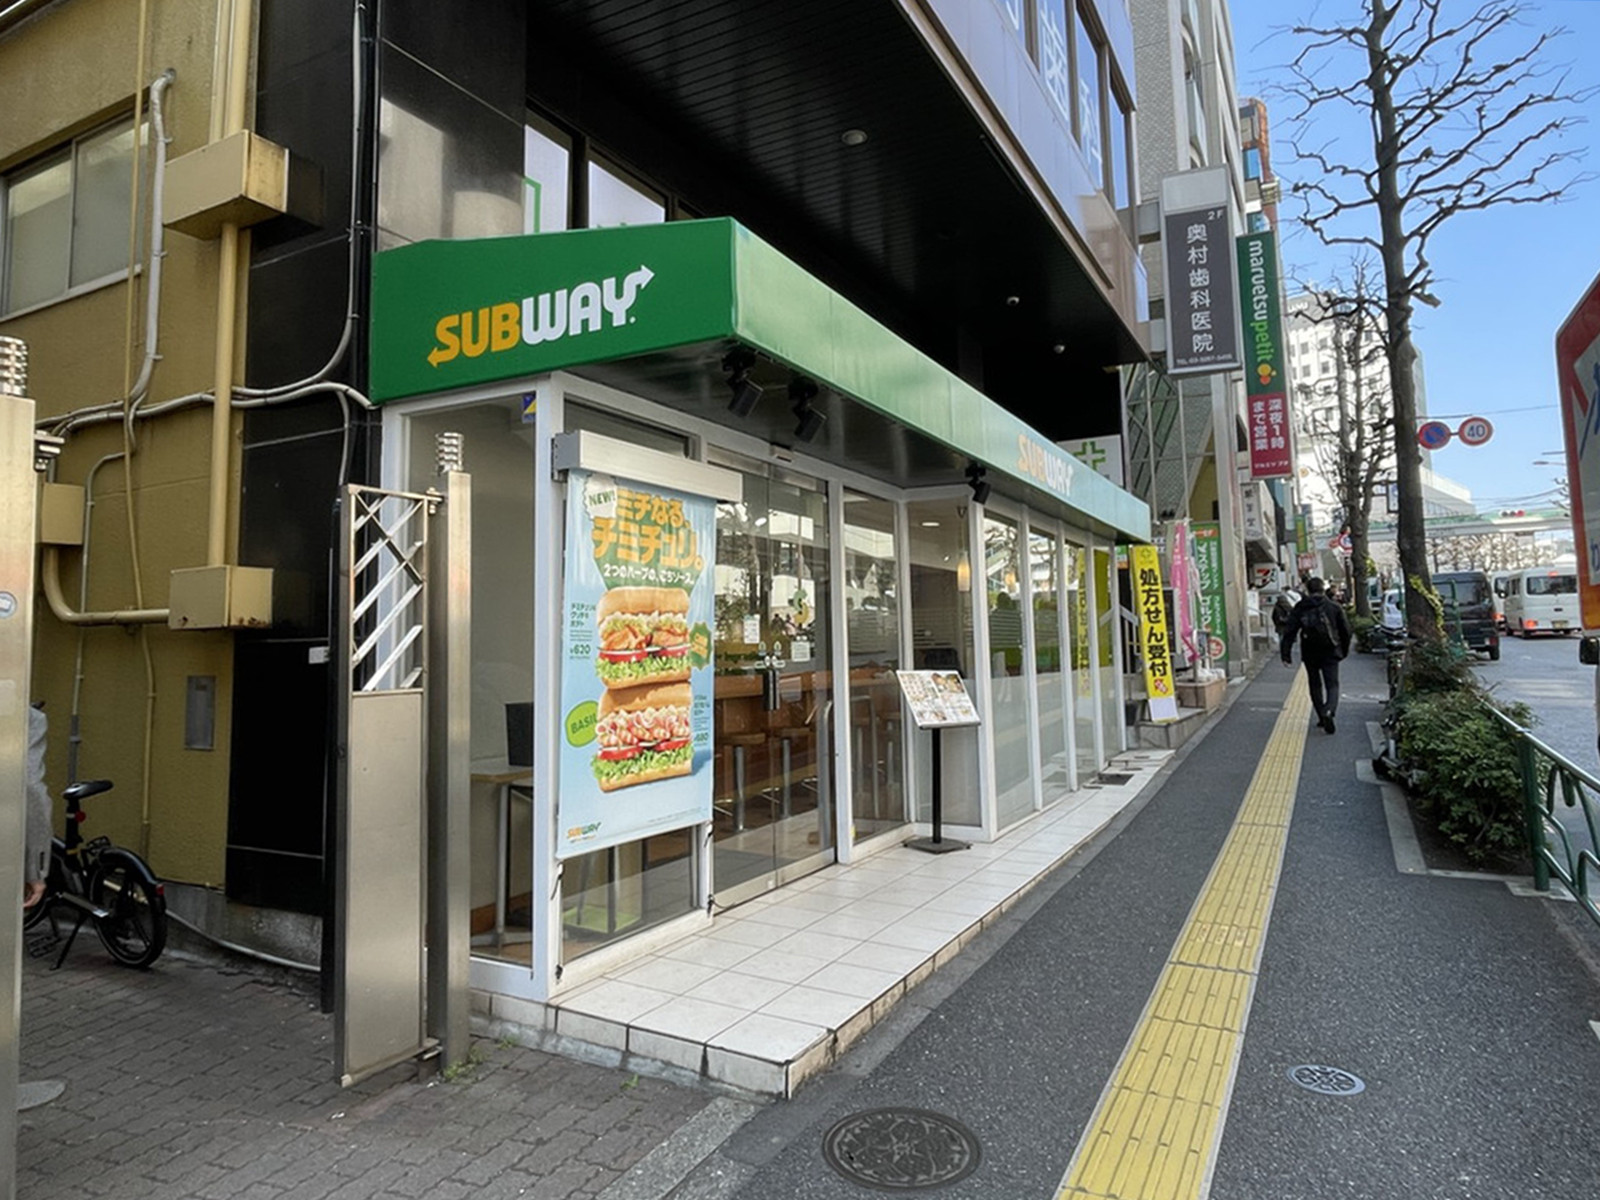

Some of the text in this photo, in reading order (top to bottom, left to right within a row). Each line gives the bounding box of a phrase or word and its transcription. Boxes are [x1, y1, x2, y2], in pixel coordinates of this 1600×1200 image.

[1207, 209, 1224, 221] 2F
[427, 264, 655, 368] SUBWAY
[1187, 223, 1214, 353] 奥村歯科医院
[1467, 424, 1486, 438] 40
[1018, 434, 1073, 497] SUBWAY
[588, 490, 616, 506] NEW!
[1139, 568, 1167, 677] 処方せん受付
